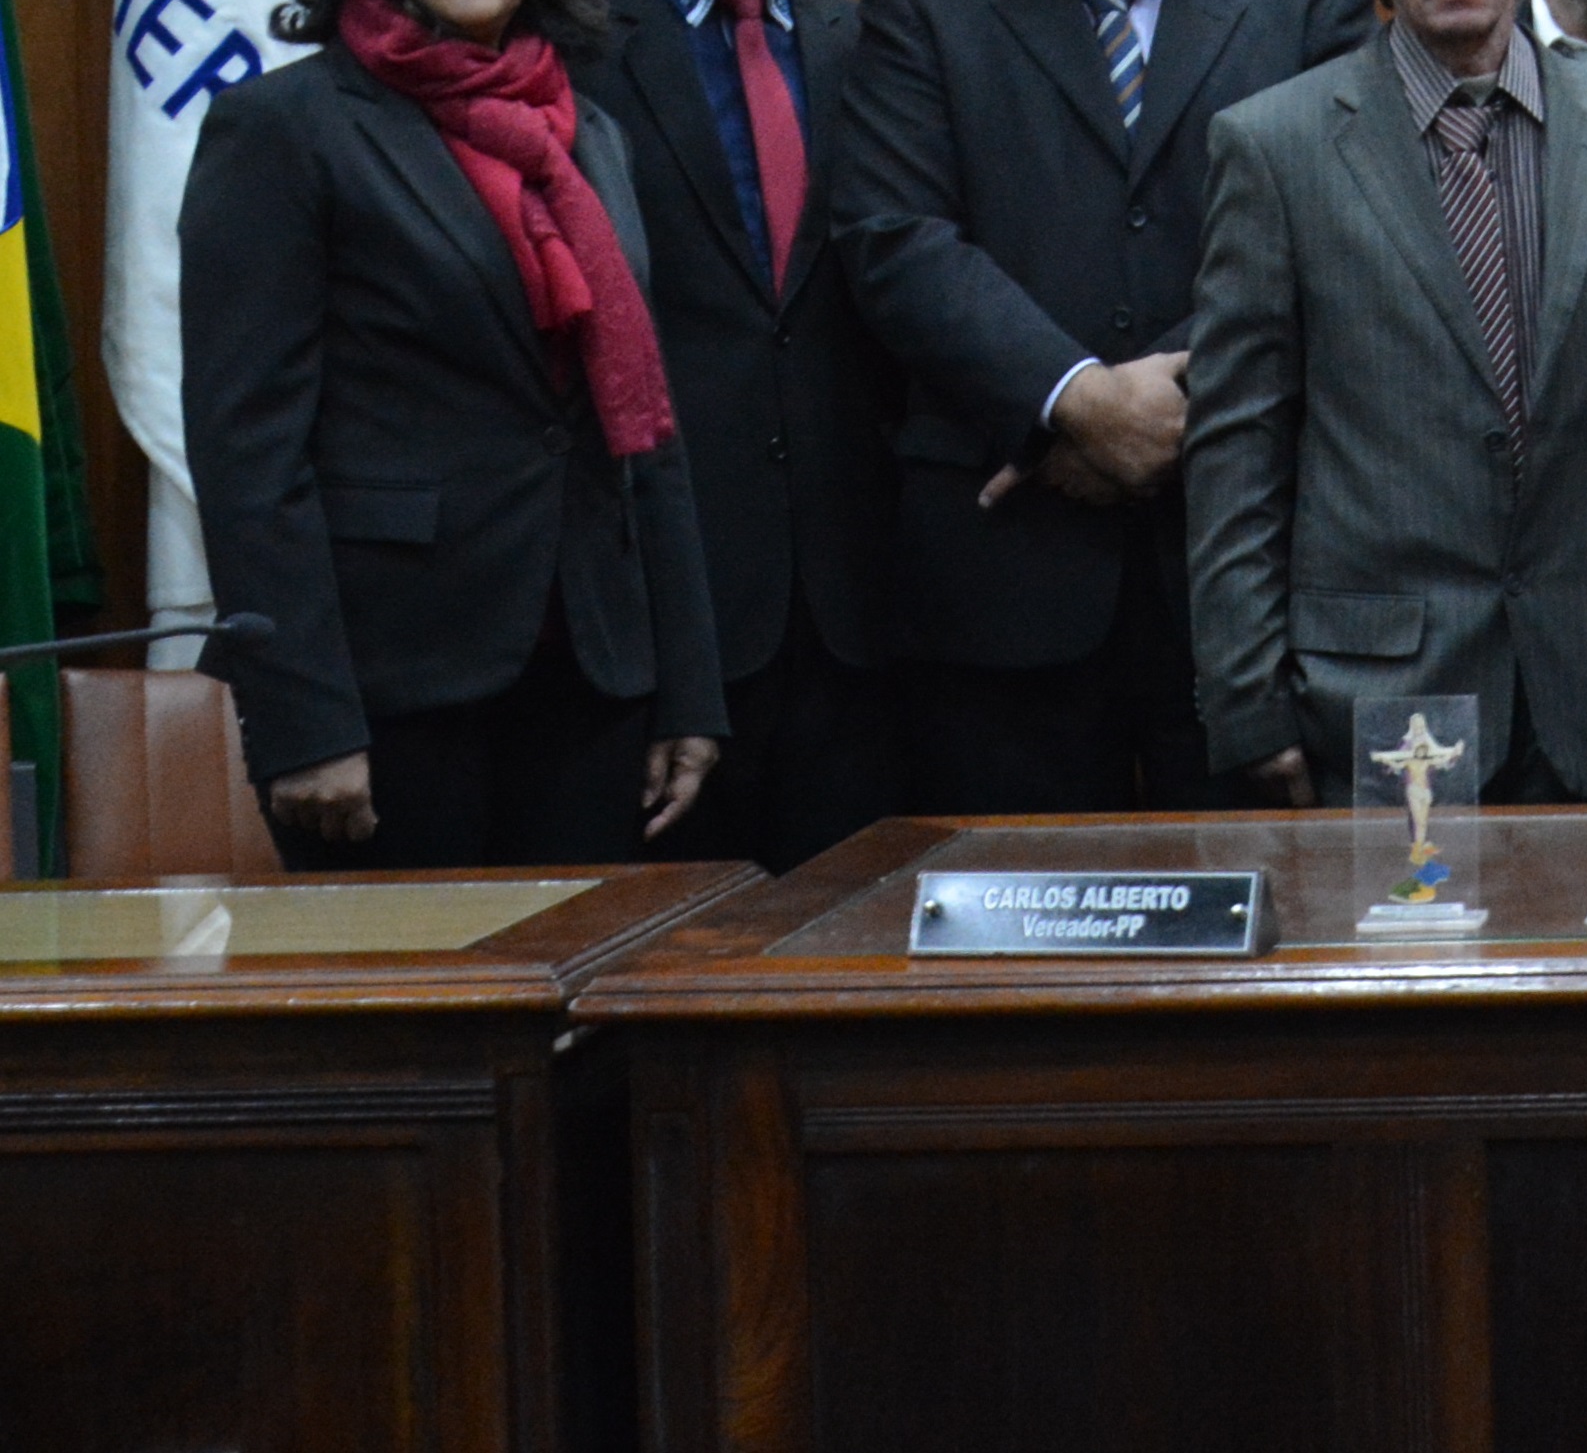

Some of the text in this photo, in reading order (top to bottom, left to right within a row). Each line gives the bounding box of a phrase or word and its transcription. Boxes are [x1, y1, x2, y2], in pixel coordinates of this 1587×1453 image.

[983, 885, 1191, 911] CARLOS ALBERTO
[1022, 913, 1146, 939] Vereador-PP
